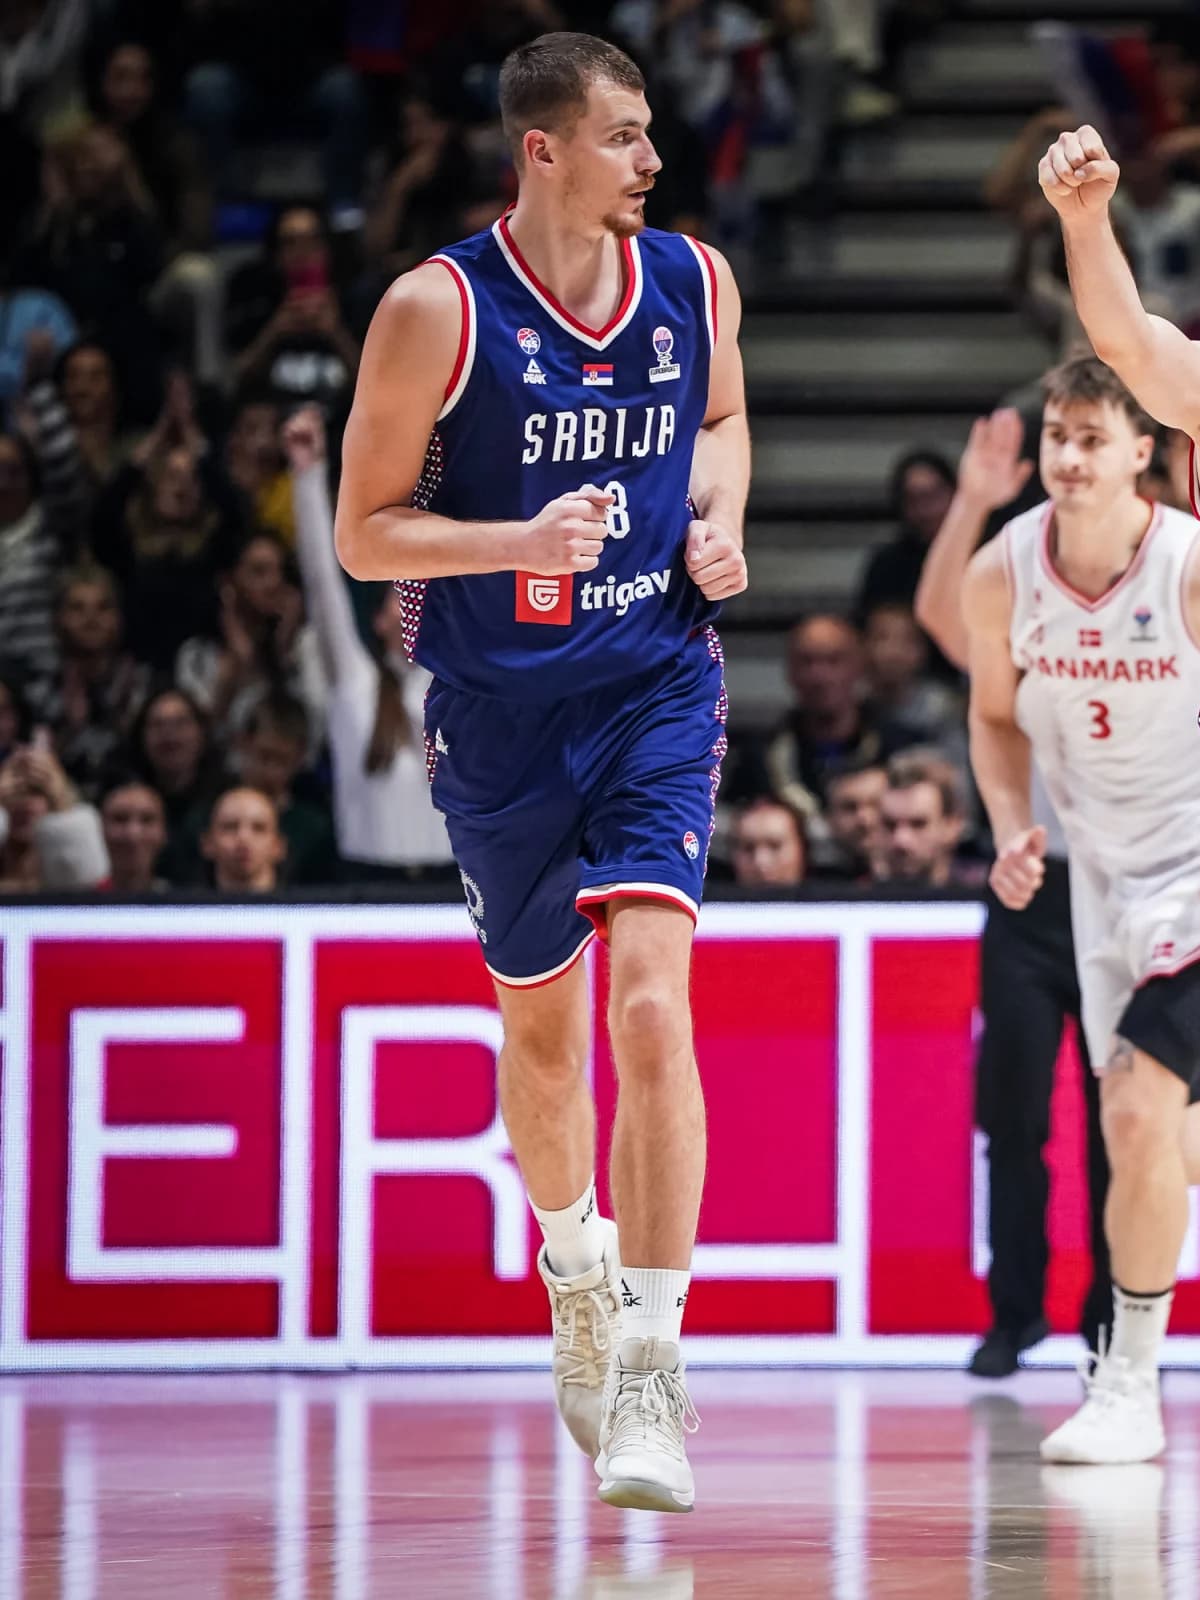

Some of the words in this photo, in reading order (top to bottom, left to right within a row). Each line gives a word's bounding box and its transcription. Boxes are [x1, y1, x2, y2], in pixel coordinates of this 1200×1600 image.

[522, 405, 675, 464] SRBIJA
[577, 480, 631, 540] 8
[1087, 699, 1111, 740] 3
